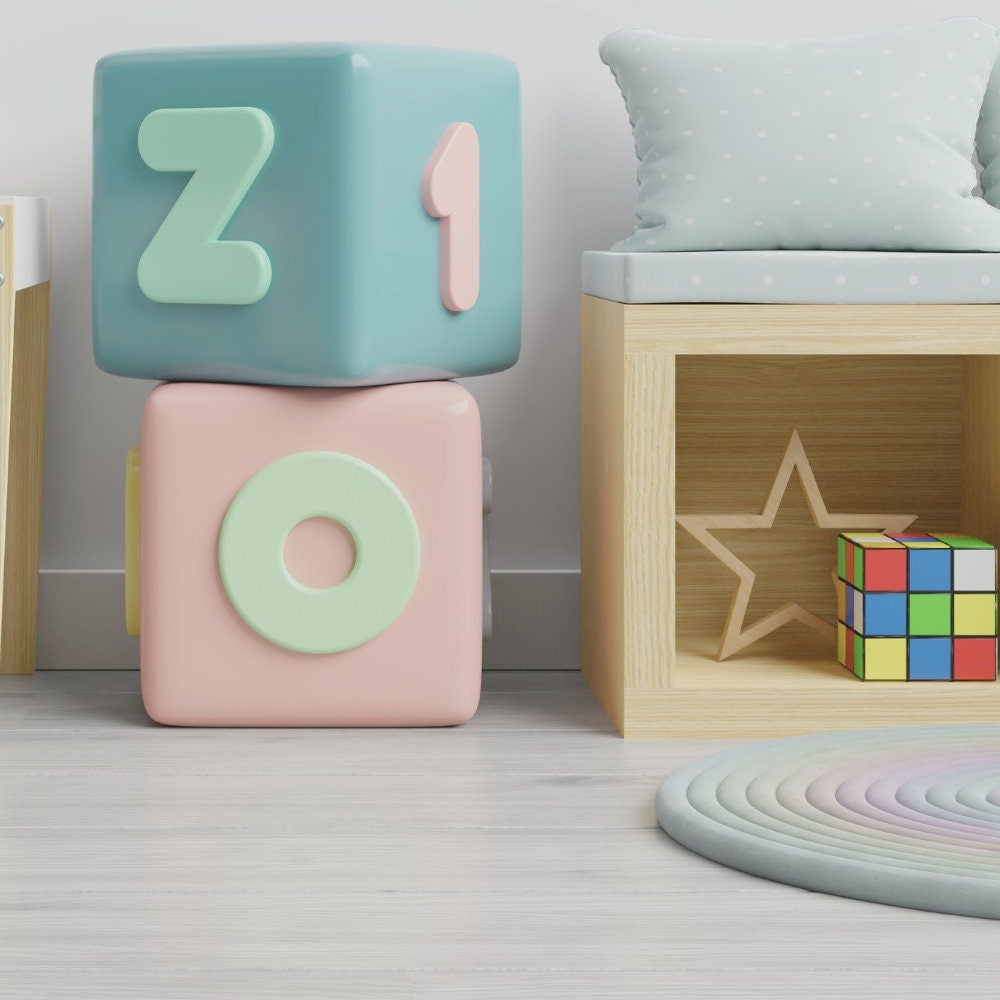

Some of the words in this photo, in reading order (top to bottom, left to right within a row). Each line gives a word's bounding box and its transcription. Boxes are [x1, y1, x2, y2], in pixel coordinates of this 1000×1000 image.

[137, 107, 275, 305] Z
[421, 122, 480, 312] 1
[218, 450, 421, 655] O
